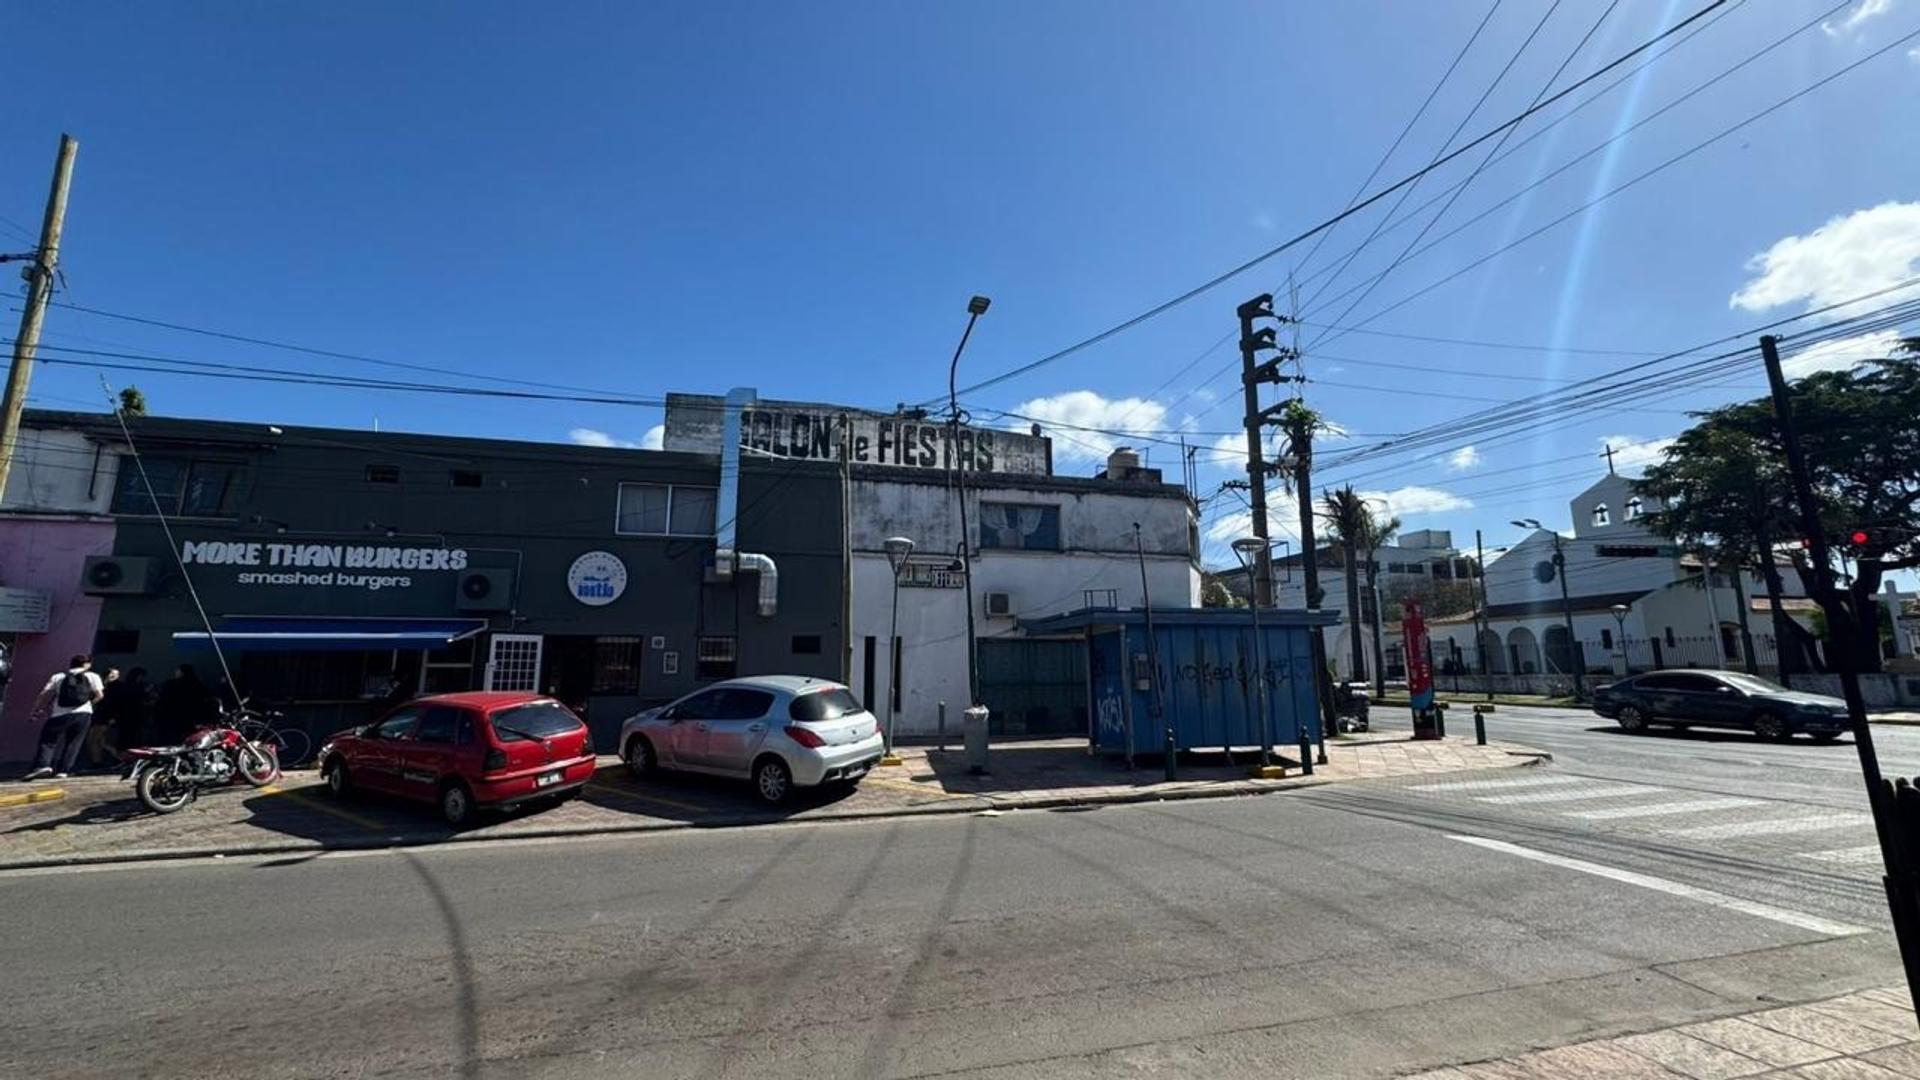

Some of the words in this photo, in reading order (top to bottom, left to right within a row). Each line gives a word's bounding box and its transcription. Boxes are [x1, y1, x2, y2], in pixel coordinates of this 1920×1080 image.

[878, 418, 993, 472] FIESTAS
[181, 541, 260, 565] MORE
[266, 543, 342, 568] THAN
[345, 547, 468, 570] BURGERS
[238, 571, 333, 585] smashed
[336, 572, 411, 589] burgers
